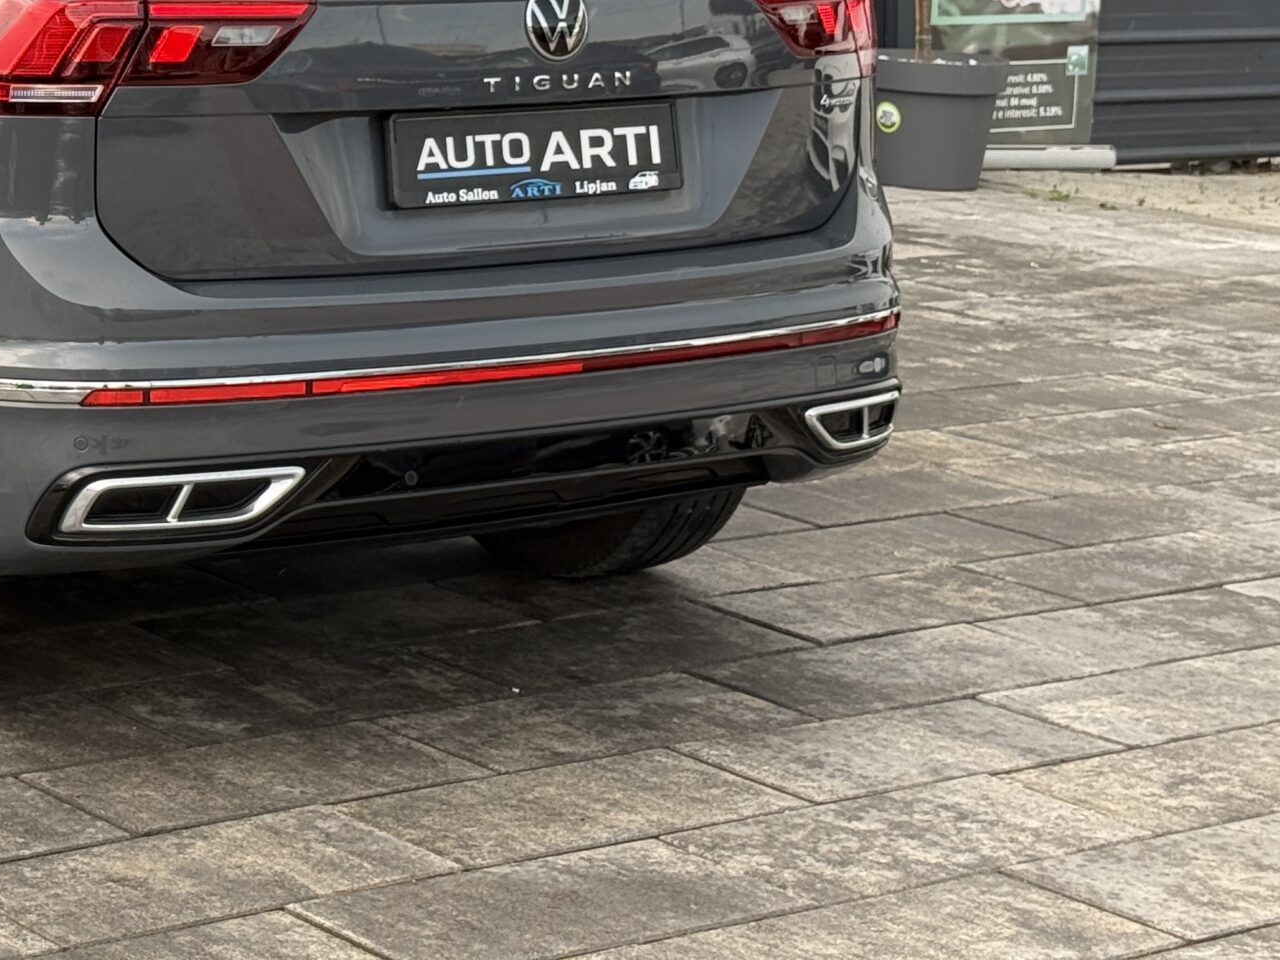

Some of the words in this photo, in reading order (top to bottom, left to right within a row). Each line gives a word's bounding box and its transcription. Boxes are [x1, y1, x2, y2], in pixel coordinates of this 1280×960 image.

[483, 71, 632, 92] TIGUAN
[417, 132, 531, 171] AUTO
[540, 125, 662, 171] ARTI
[425, 191, 457, 204] Auto
[459, 187, 499, 202] Sallon
[511, 183, 562, 198] ARTI
[575, 180, 617, 194] Lipjan
